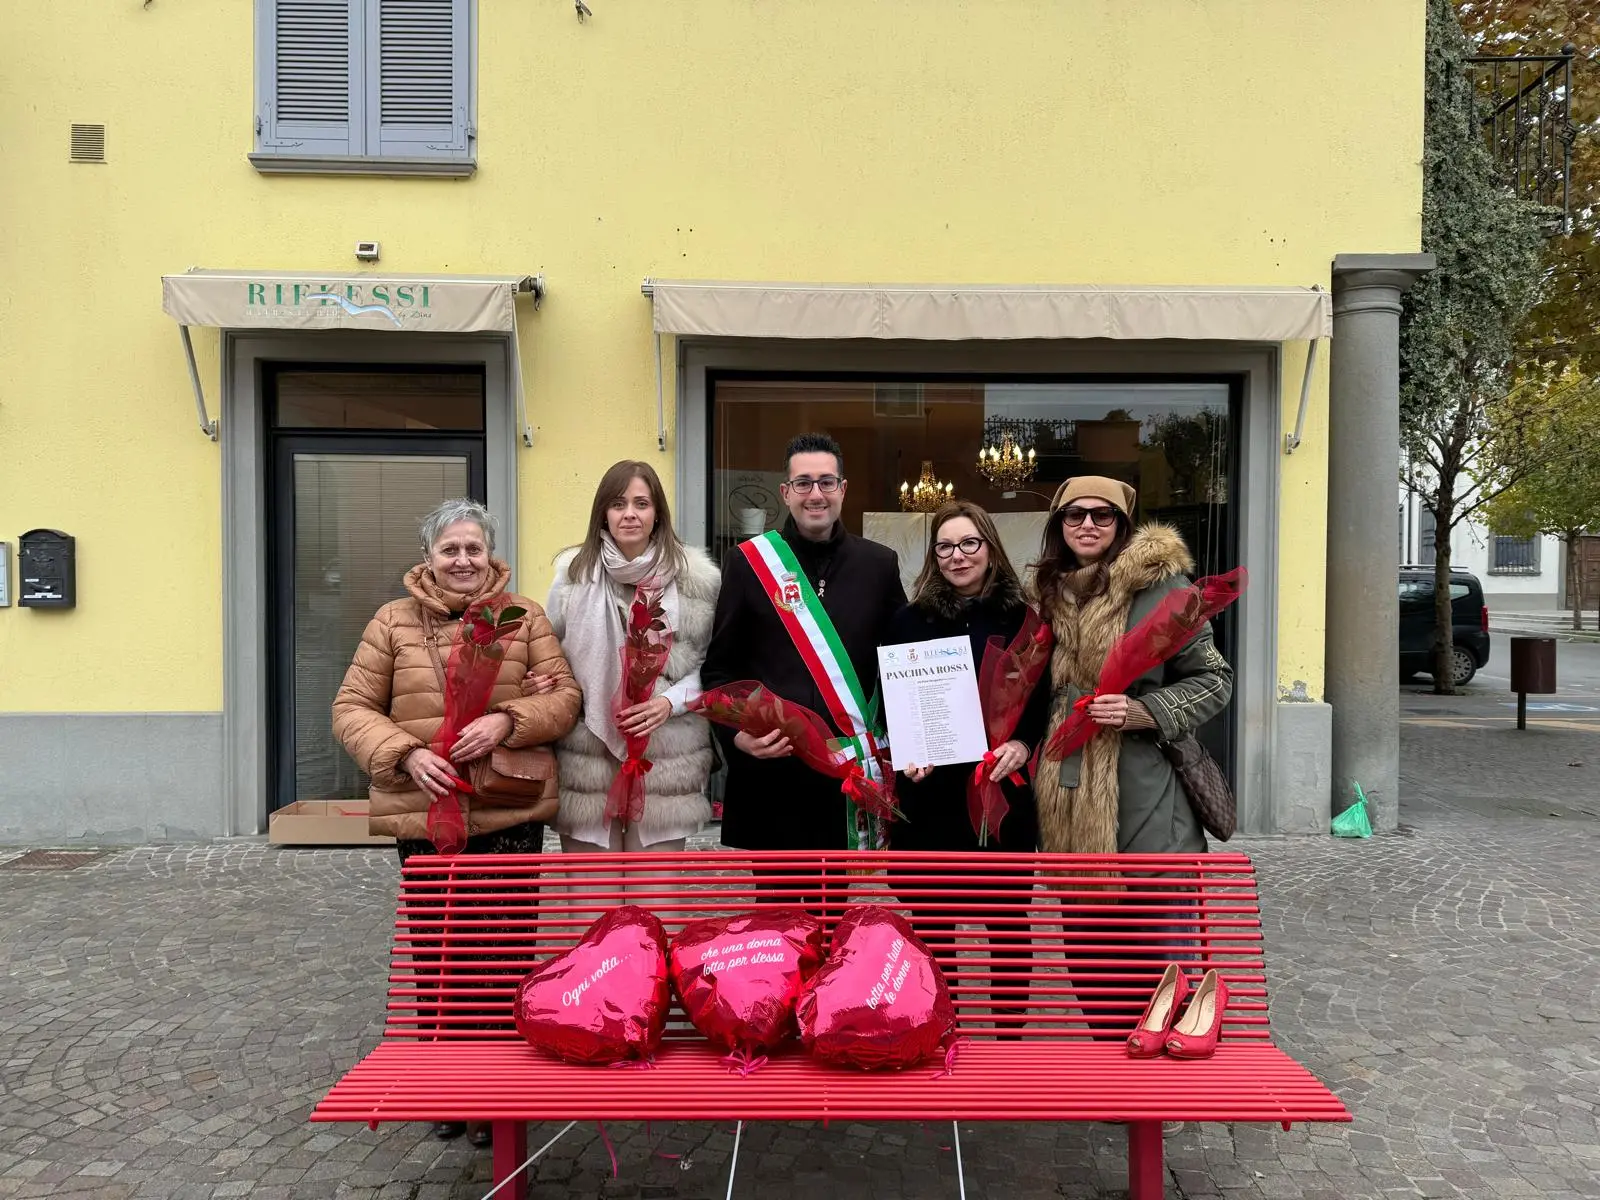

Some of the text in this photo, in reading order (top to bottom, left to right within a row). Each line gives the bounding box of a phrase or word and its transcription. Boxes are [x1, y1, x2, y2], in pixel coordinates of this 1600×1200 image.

[248, 283, 431, 308] RIFLESSI
[886, 663, 969, 680] PANCHINA ROSSA
[701, 938, 781, 960] che una donna
[703, 952, 785, 976] lotta per stessa
[865, 938, 905, 1010] lotta per tutte
[562, 978, 591, 1006] Ogni
[884, 959, 911, 1005] le donne
